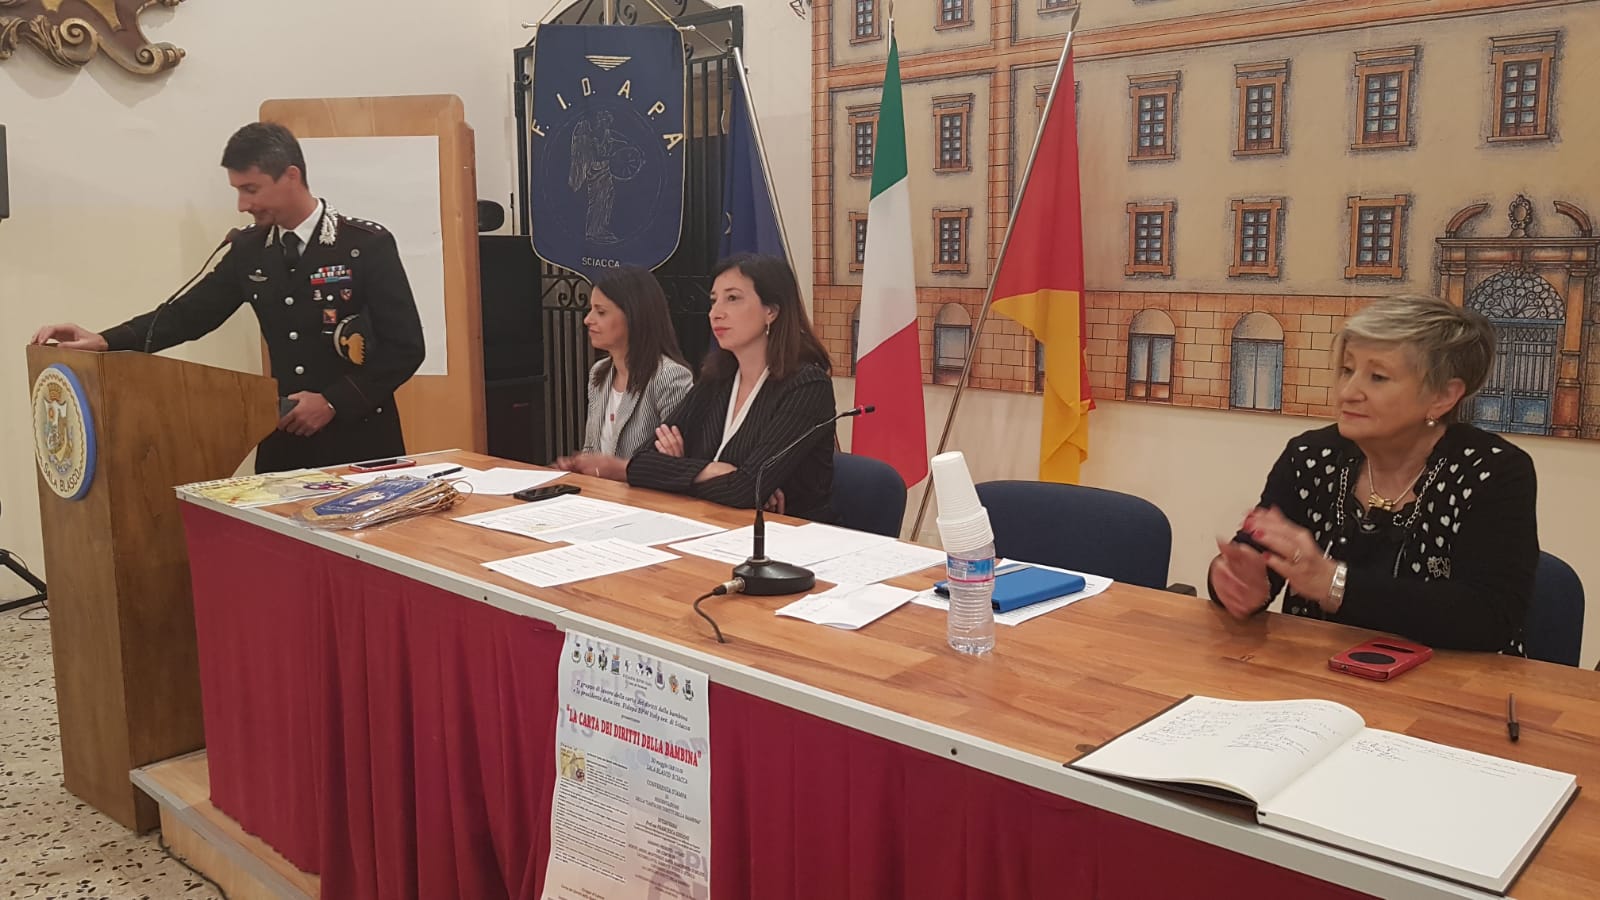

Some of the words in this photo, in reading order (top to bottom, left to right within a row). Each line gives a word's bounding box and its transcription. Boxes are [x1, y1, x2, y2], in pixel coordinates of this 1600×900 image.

[582, 256, 620, 268] SCIACCA
[43, 462, 58, 489] SALA
[60, 468, 80, 493] BLASCO
[579, 711, 600, 732] CARTA
[600, 719, 612, 737] DEI
[613, 723, 641, 746] DIRITTI
[641, 733, 663, 755] DELLA
